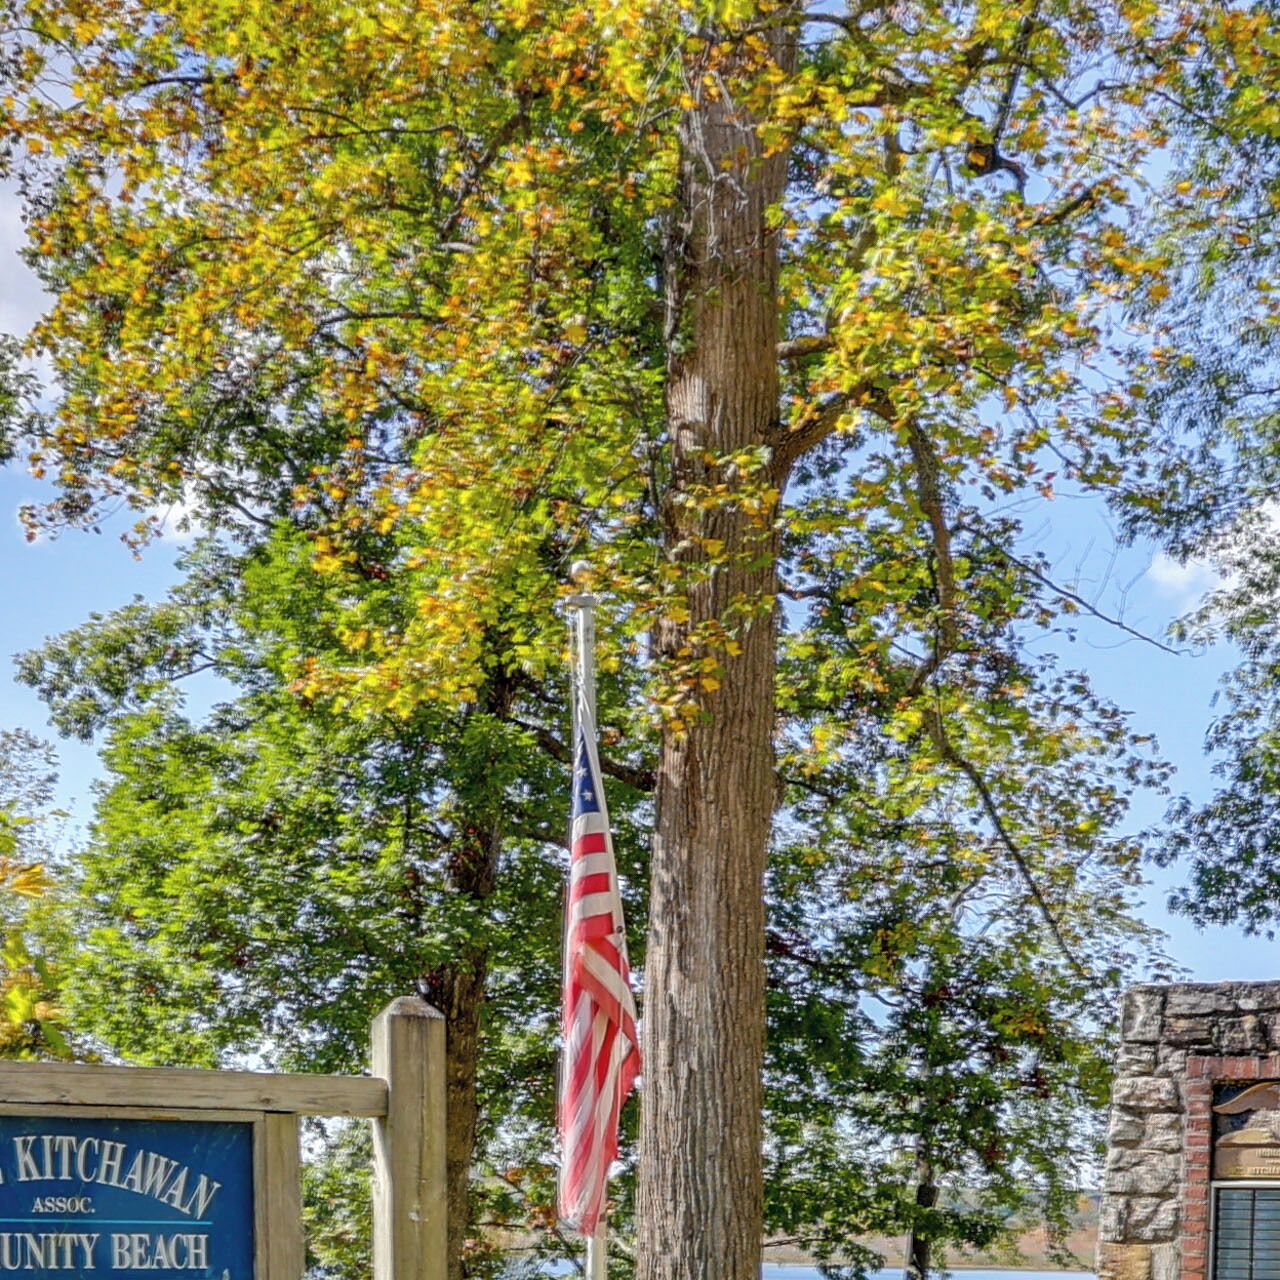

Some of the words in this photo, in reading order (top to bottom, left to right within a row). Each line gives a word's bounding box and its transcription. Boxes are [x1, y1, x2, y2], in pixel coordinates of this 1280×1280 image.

[13, 1135, 222, 1220] KITCHAWAN
[32, 1197, 96, 1214] ASSOC.
[111, 1233, 209, 1270] BEACH
